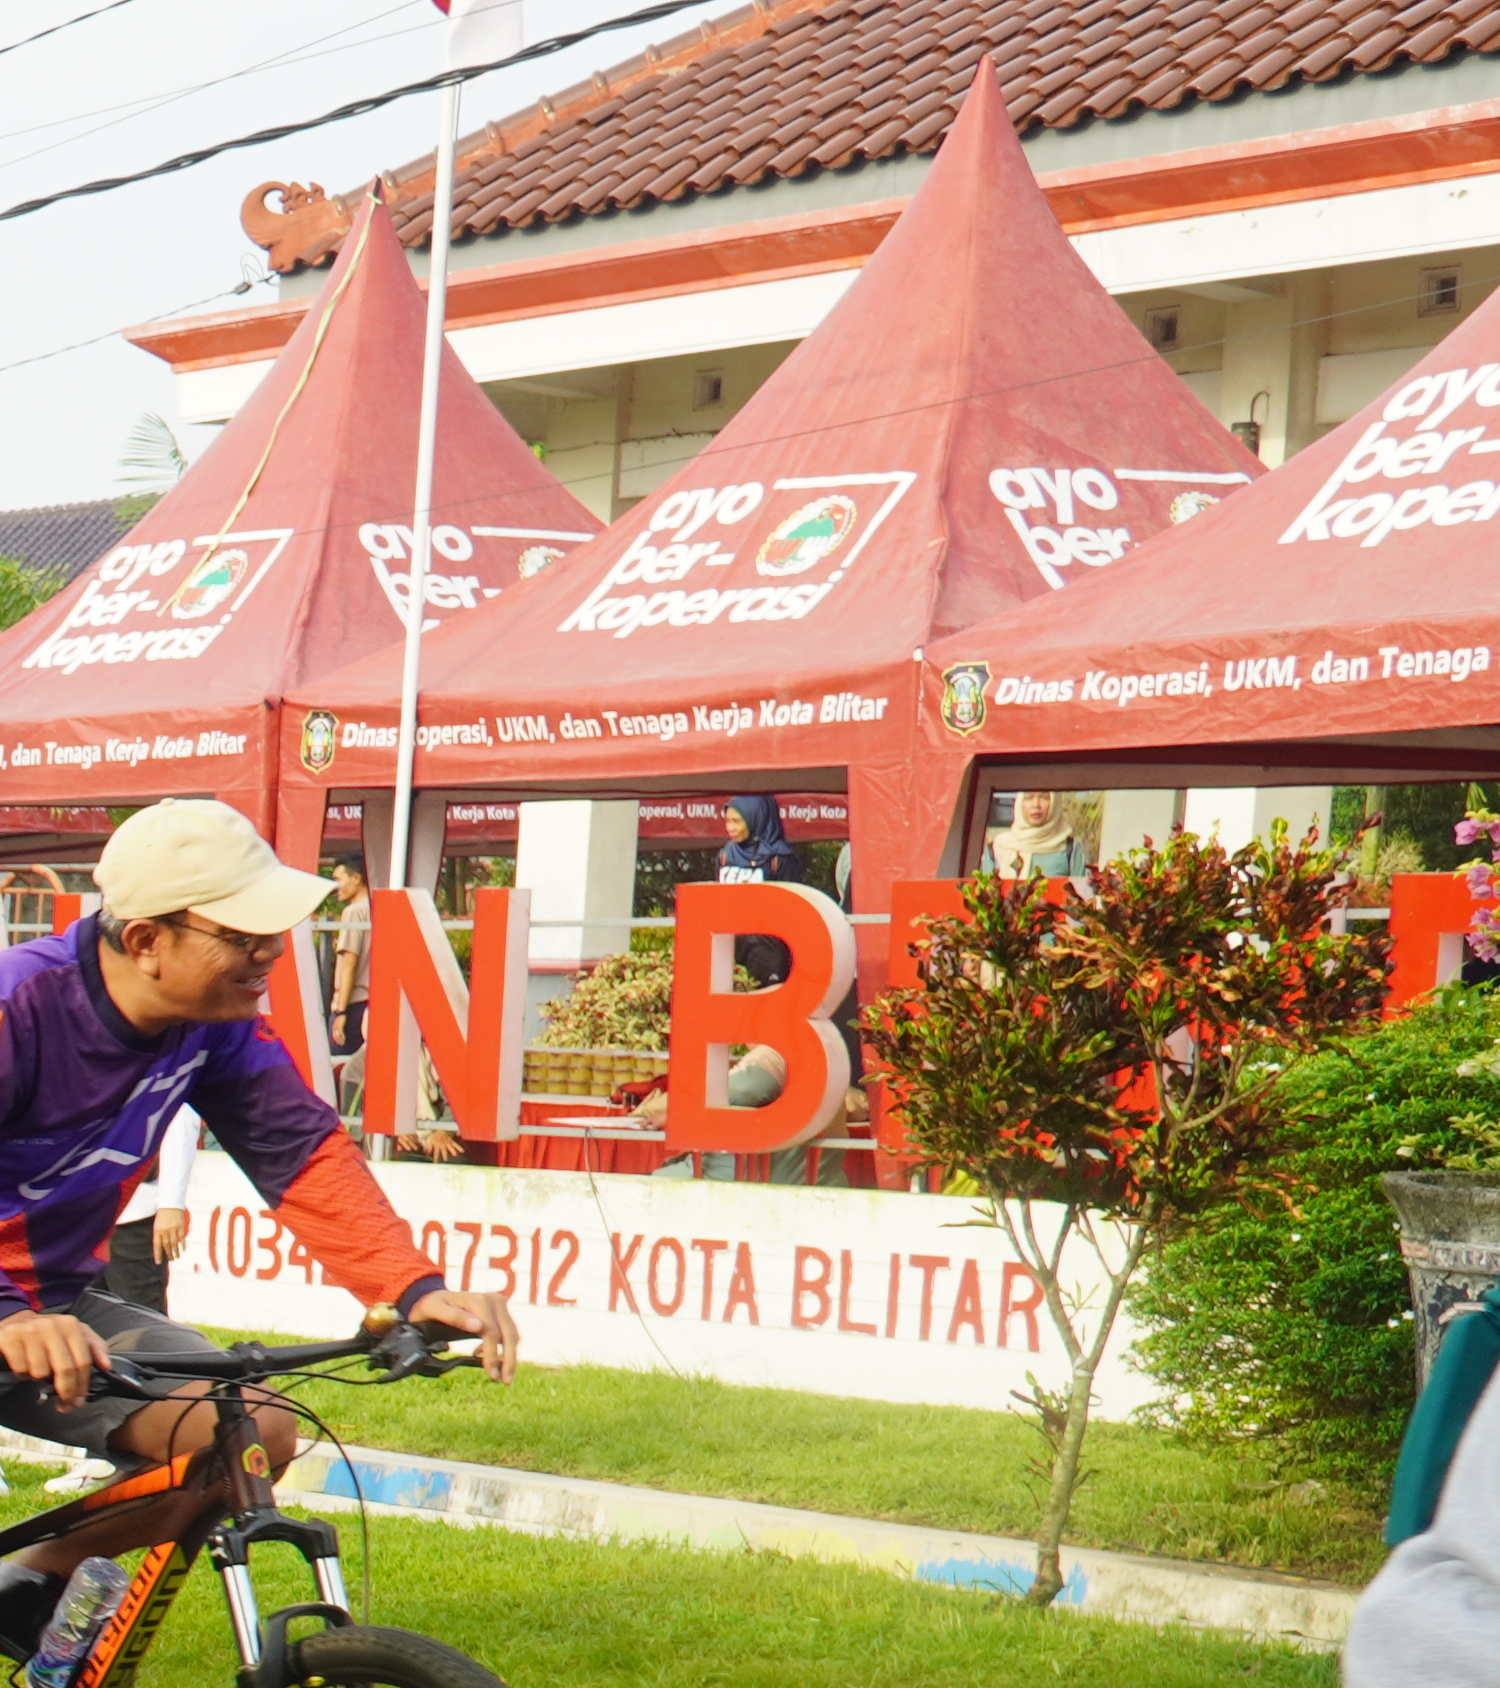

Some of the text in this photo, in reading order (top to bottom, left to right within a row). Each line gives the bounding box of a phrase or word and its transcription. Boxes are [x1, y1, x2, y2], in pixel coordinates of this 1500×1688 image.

[649, 481, 764, 542] ayo
[988, 467, 1118, 524] ayo
[97, 537, 186, 591] ayo
[609, 530, 736, 586] ber-
[67, 579, 160, 628] ber-
[557, 570, 845, 638] koperasi
[22, 612, 232, 675] koperasi
[995, 645, 1490, 707] Dinas Koperasi, UKM, dan Tenaga
[11, 742, 41, 767] dan
[45, 740, 102, 769] Tenaga
[105, 737, 150, 767] Kerja
[152, 735, 194, 760] Kota
[197, 731, 247, 757] Blitar
[341, 693, 887, 752] Dinas operasi, UKM, dan Tenaga Kerja Kota Blitar
[452, 805, 484, 824] Kerja
[487, 805, 516, 820] Kota
[638, 803, 684, 821] operasi,
[789, 805, 818, 823] Kerja
[820, 805, 846, 819] Kota
[607, 1230, 760, 1329] KOTA
[790, 1244, 1045, 1354] BLITAR
